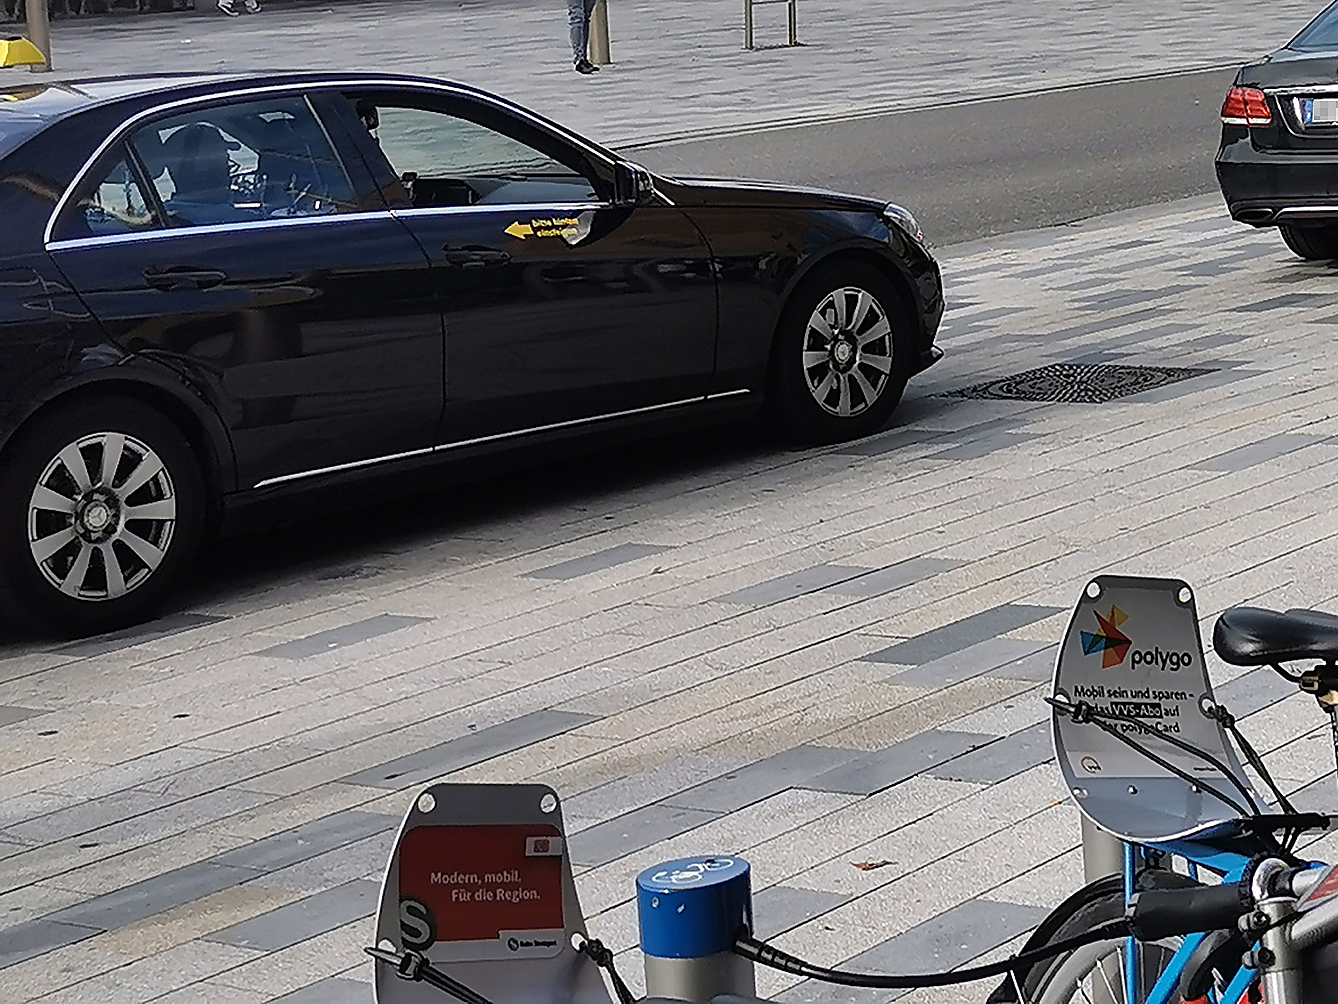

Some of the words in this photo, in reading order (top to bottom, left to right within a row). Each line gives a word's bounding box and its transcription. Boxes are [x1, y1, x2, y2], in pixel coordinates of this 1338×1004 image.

[1131, 646, 1193, 671] polygo
[1073, 685, 1105, 700] Mobil
[1106, 686, 1129, 698] sein
[1130, 687, 1151, 698] und
[1152, 689, 1188, 702] sparen
[1112, 704, 1161, 717] VVS-Abo
[1163, 705, 1180, 717] auf
[430, 871, 482, 886] Modern,
[484, 869, 522, 884] mobil.
[451, 888, 472, 903] Für
[474, 888, 494, 902] die
[496, 886, 541, 904] Region.
